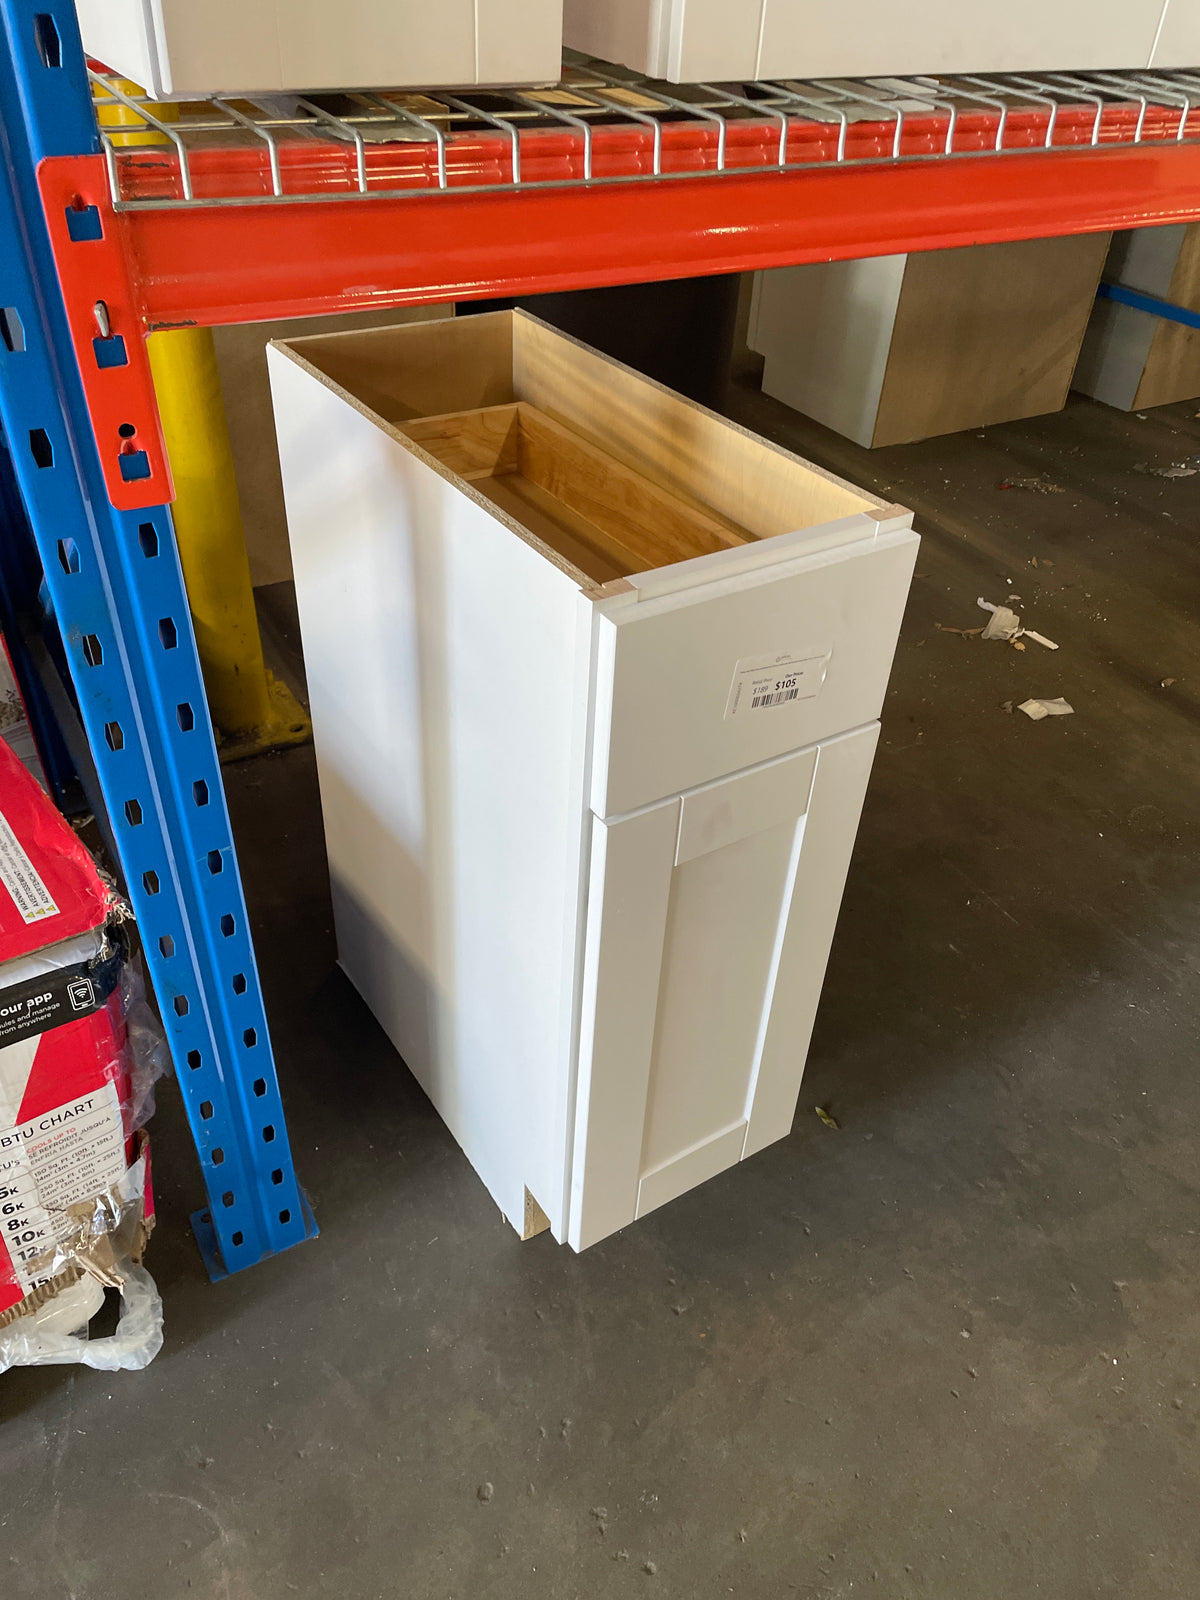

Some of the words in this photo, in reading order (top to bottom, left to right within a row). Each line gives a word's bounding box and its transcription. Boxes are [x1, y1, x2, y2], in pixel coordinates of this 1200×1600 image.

[775, 678, 797, 691] $105
[26, 992, 53, 1007] app
[17, 1011, 31, 1022] and
[32, 1002, 61, 1016] manage
[17, 1013, 52, 1029] anywhere
[1, 1127, 34, 1148] BTU
[40, 1099, 94, 1130] CHART
[26, 1138, 52, 1153] COOLS
[53, 1132, 64, 1141] UP
[66, 1127, 76, 1135] TO
[28, 1152, 37, 1160] SE
[39, 1132, 78, 1154] REFROIDIT
[34, 1168, 47, 1177] 150
[0, 1186, 19, 1200] 5K
[40, 1183, 53, 1193] 250
[1, 1201, 25, 1216] 6K
[7, 1217, 29, 1232] 8K
[11, 1228, 46, 1246] 10K
